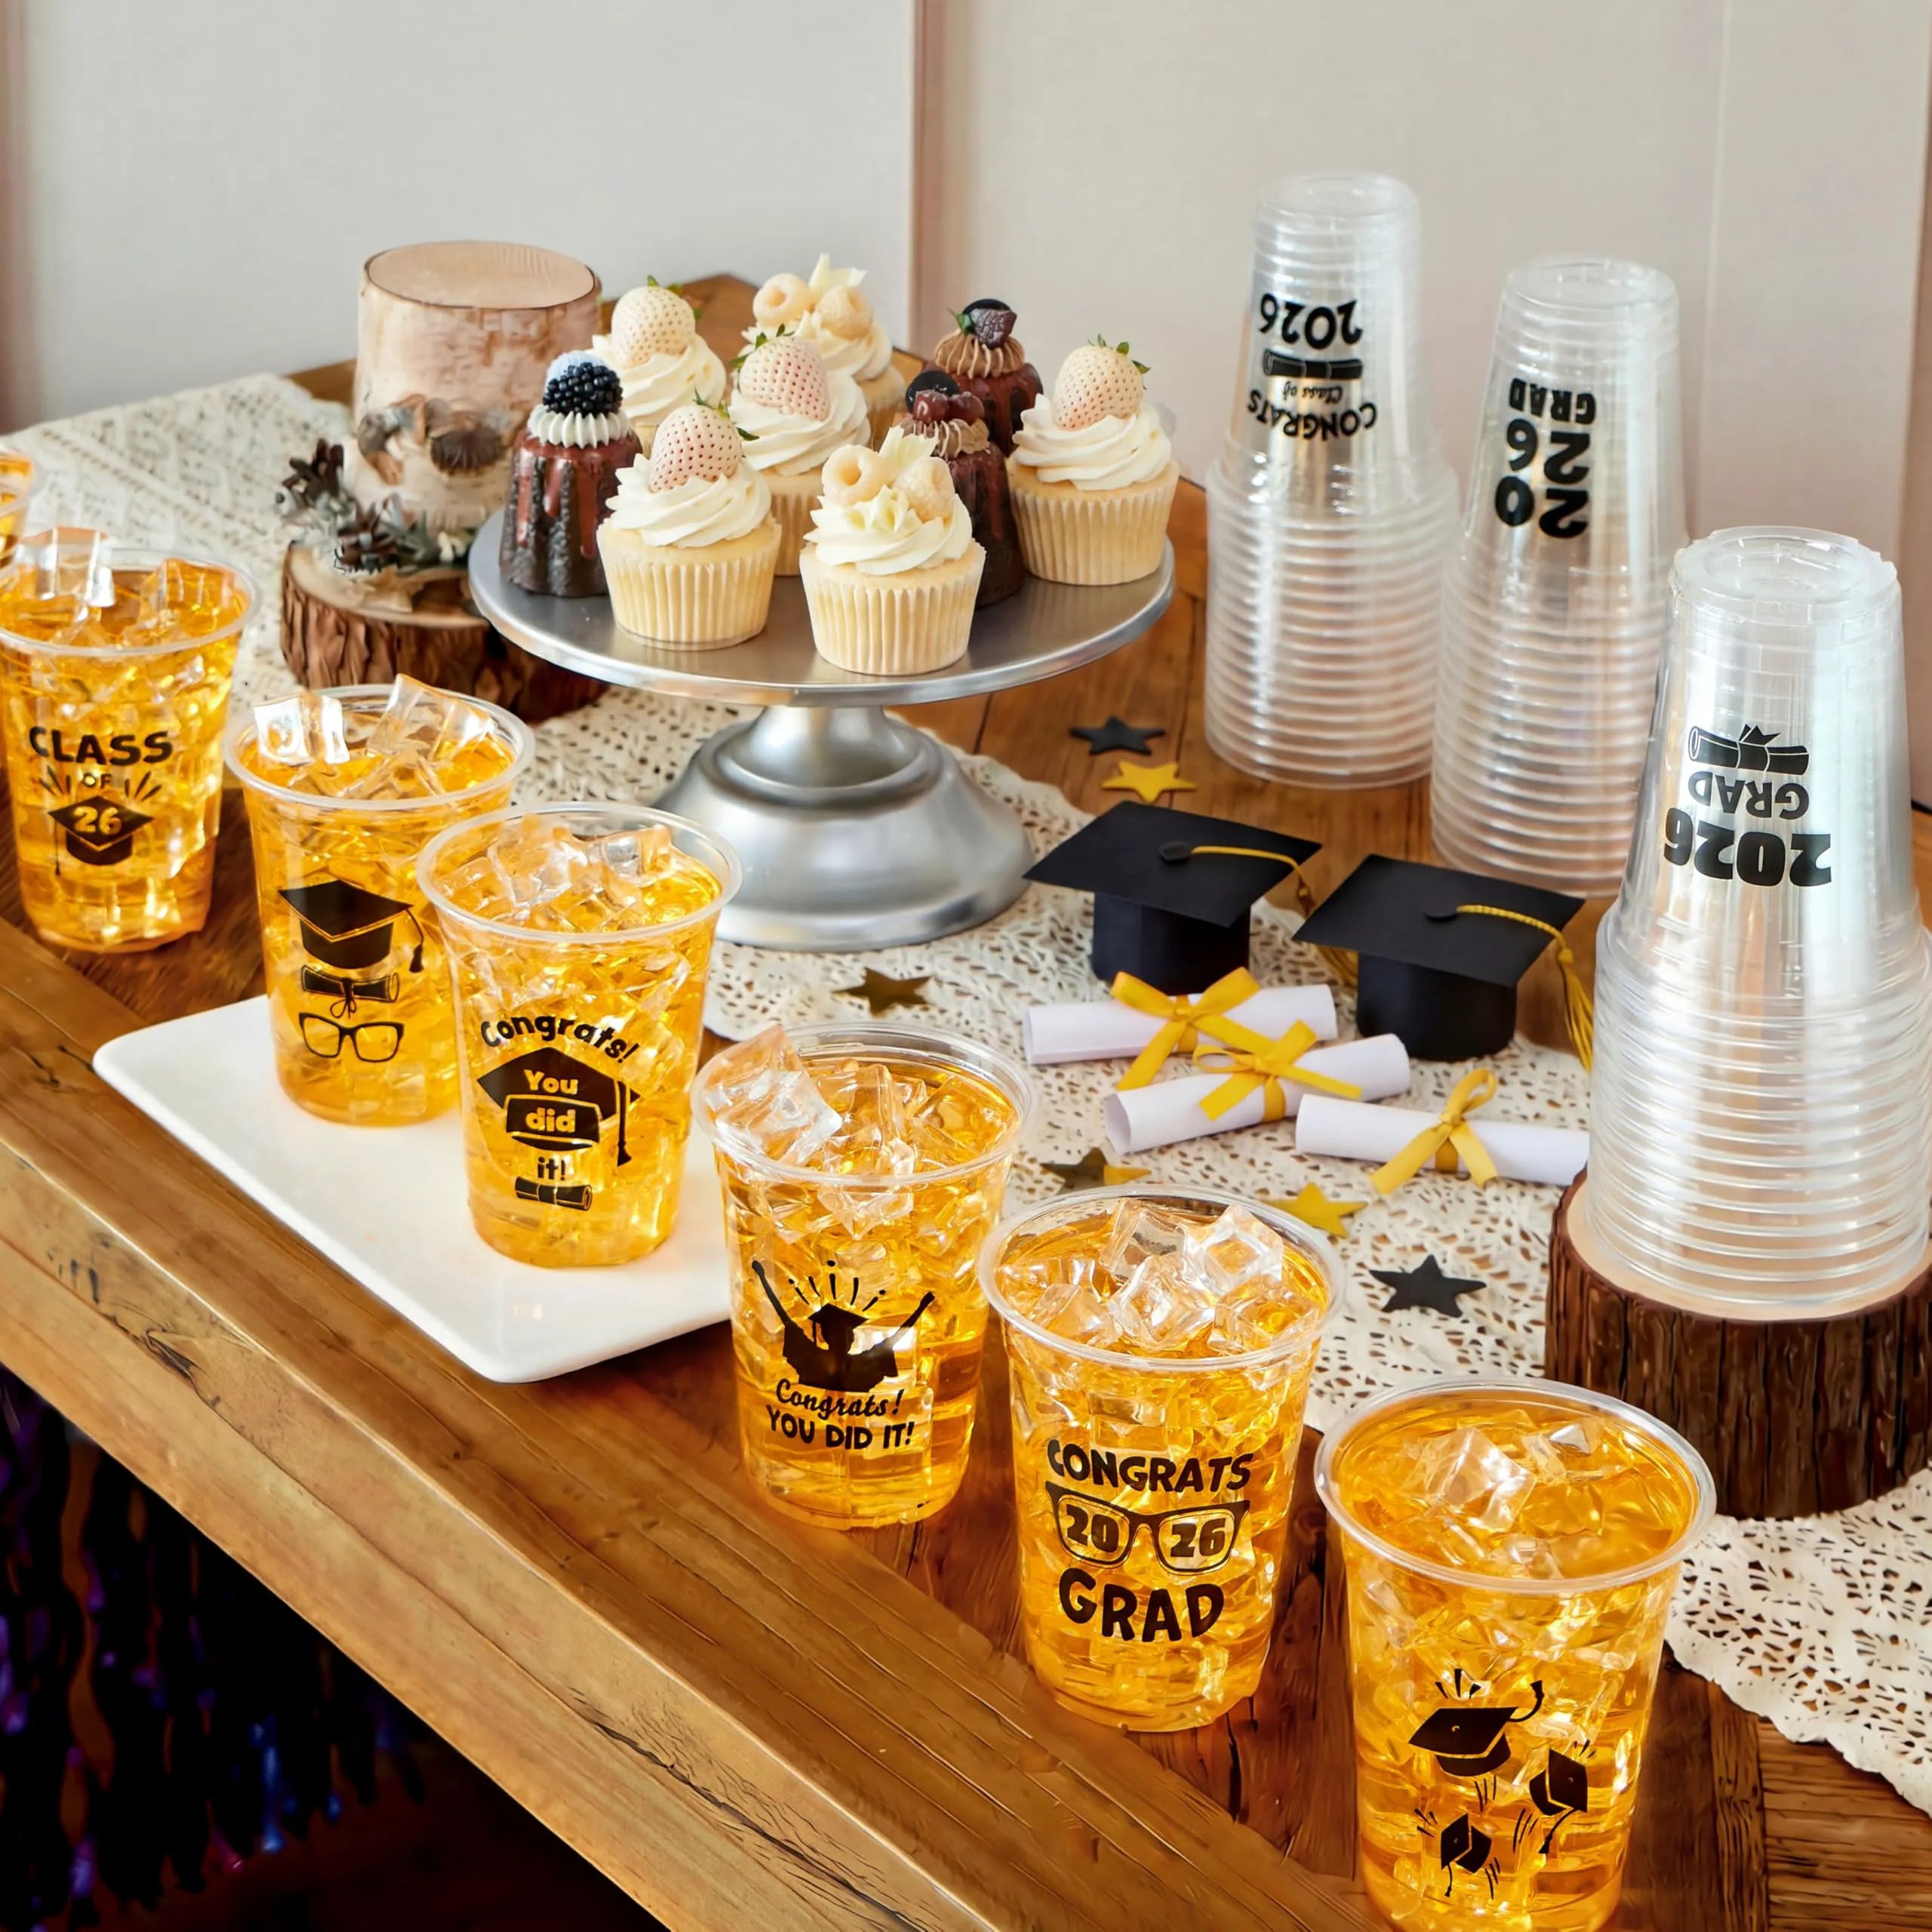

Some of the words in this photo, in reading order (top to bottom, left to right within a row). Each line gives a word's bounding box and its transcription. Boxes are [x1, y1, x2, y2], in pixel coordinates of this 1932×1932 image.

[1259, 293, 1363, 349] 2026
[1283, 380, 1297, 401] of
[1302, 385, 1343, 405] Class
[1509, 377, 1596, 425] GRAD
[1247, 389, 1377, 440] CONGRATS
[29, 725, 173, 765] CLASS
[82, 773, 112, 788] OF
[1687, 771, 1810, 820] GRAD
[73, 805, 122, 835] 26
[1663, 807, 1832, 887] 2026
[481, 1015, 640, 1063] Congrats!
[524, 1069, 579, 1095] You
[525, 1107, 576, 1133] did
[537, 1156, 567, 1181] it!
[776, 1378, 905, 1420] Congrats!
[766, 1404, 816, 1444] YOU
[826, 1423, 873, 1450] DID
[882, 1421, 915, 1449] IT!
[1047, 1438, 1254, 1493] CONGRATS
[1066, 1504, 1120, 1553] 20
[1170, 1518, 1226, 1558] 26
[1059, 1567, 1225, 1642] GRAD
